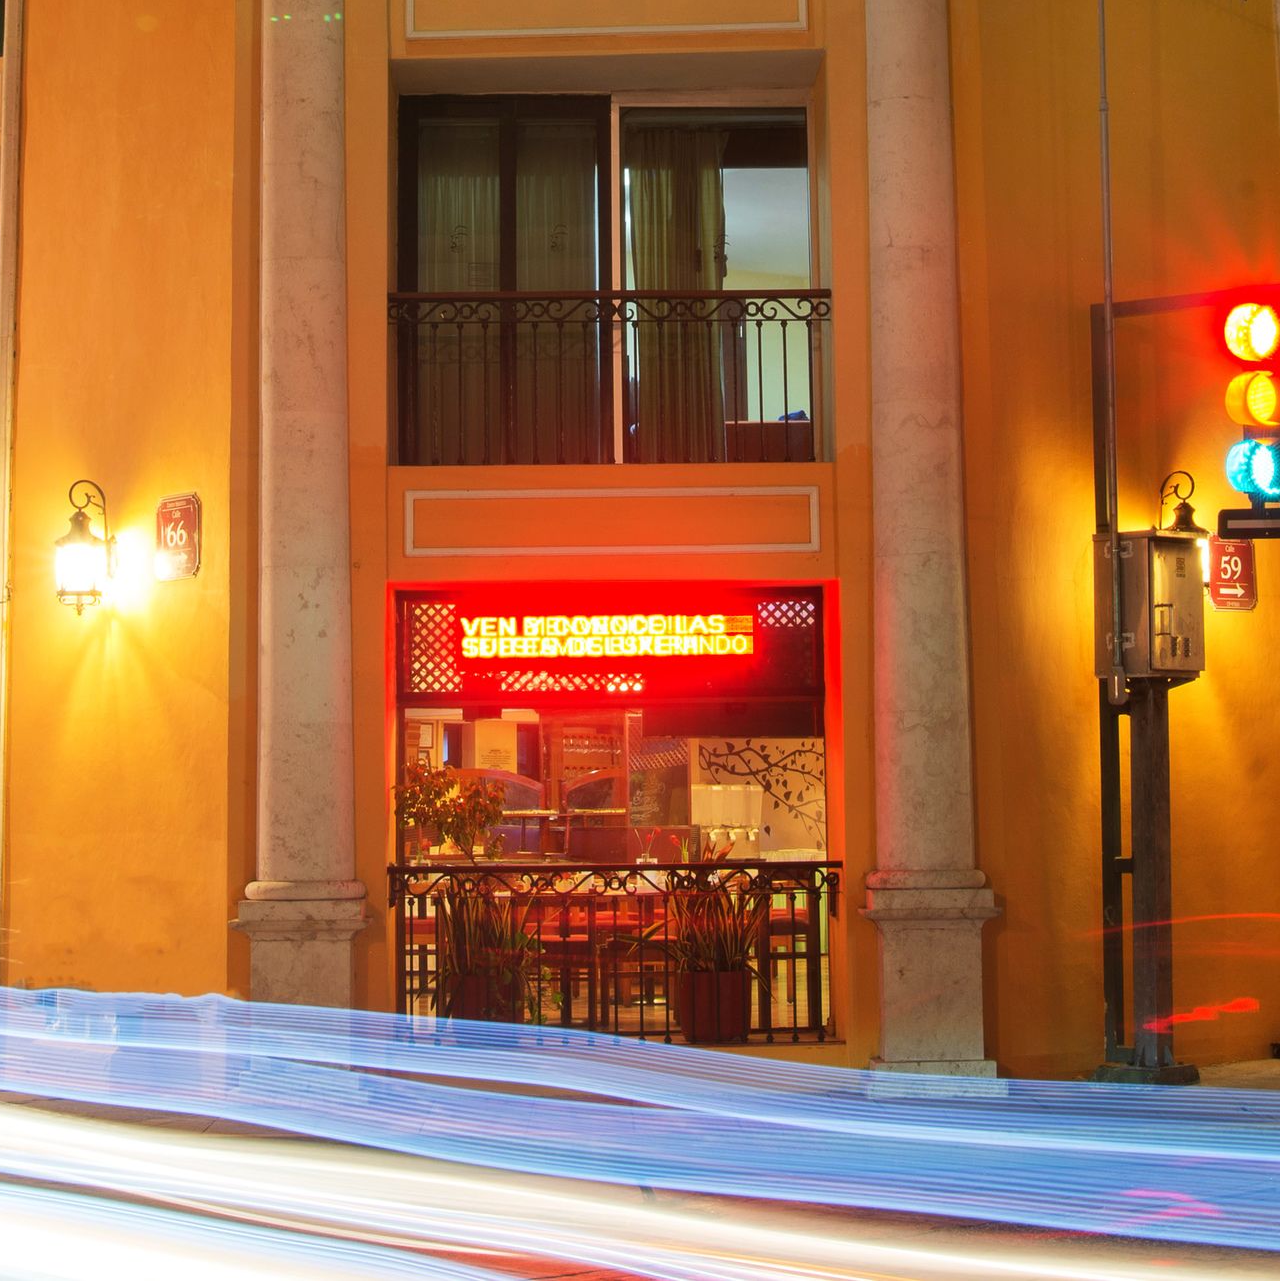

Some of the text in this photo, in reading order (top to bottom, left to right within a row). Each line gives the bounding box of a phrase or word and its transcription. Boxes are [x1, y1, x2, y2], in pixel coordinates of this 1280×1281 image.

[166, 520, 187, 548] 66
[1220, 554, 1242, 580] 59
[460, 616, 516, 637] VEN
